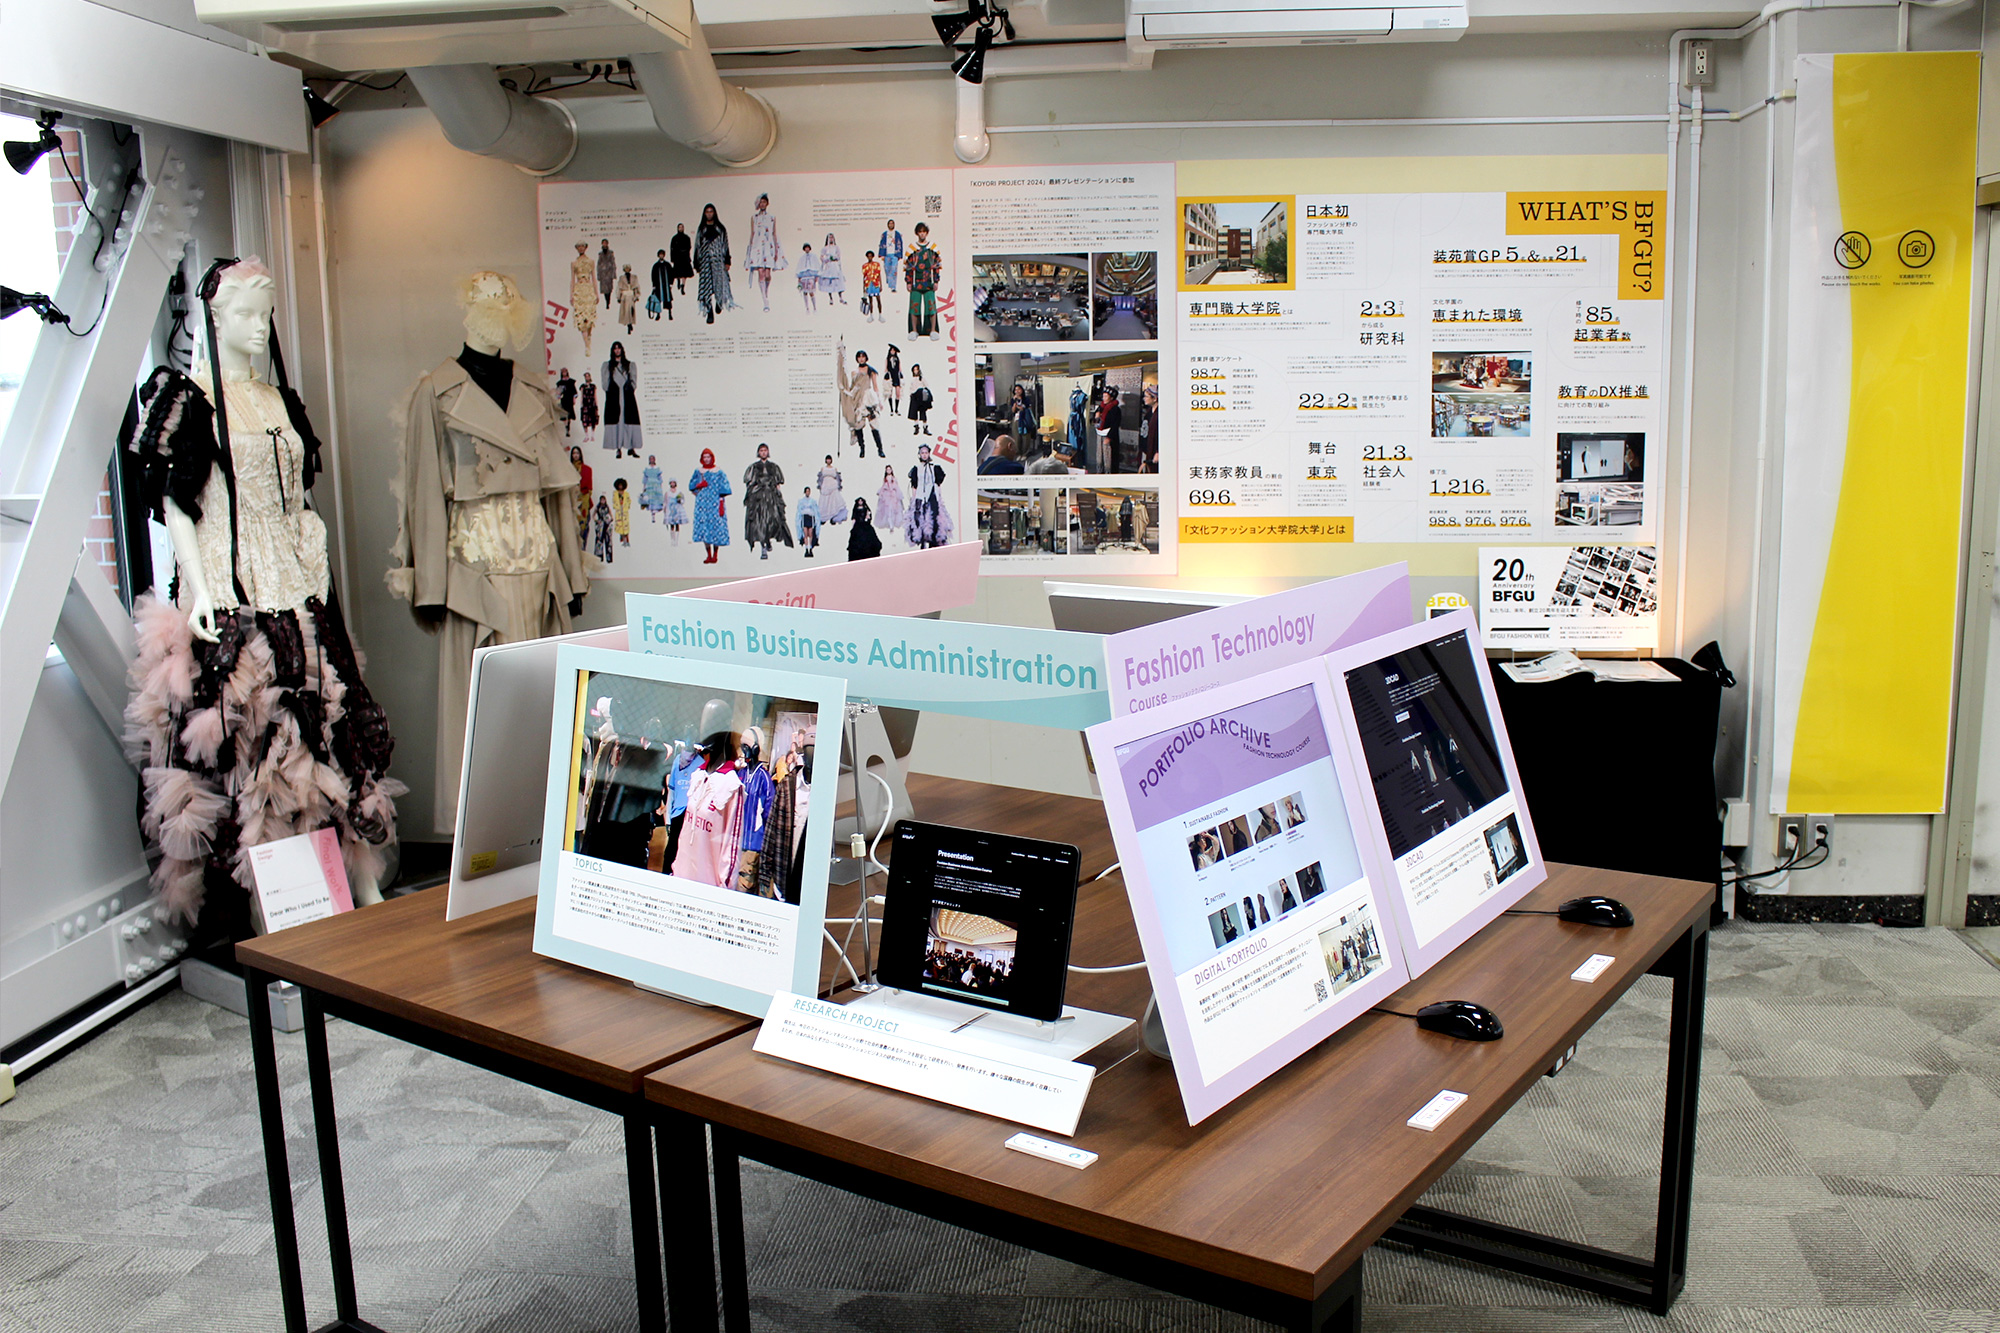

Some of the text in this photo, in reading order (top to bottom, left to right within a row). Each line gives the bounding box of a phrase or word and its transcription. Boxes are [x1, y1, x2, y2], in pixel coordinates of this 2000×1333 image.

[1049, 177, 1135, 185] 最終プレゼンテーションに参加
[1306, 204, 1350, 218] 日本初
[1519, 201, 1628, 221] WHAT'S
[1306, 221, 1358, 229] ファッション分野の
[1633, 201, 1654, 293] BFGU?
[1432, 309, 1523, 323] 恵まれた環境
[1360, 332, 1405, 345] 研究科
[1574, 328, 1631, 341] 起業者数
[1558, 385, 1649, 399] 教育のDX推進
[1308, 441, 1337, 455] 舞台
[1307, 466, 1338, 479] 東京
[1363, 465, 1406, 479] 社会人
[1184, 524, 1346, 536] 「文化ファッション大学院大学」とは
[1426, 596, 1470, 607] BFGU
[1493, 590, 1535, 602] BFGU
[642, 616, 1098, 690] Fashion Business Administration
[1125, 613, 1315, 690] Fashion Technology
[1129, 692, 1168, 714] Course
[1243, 735, 1311, 760] FASHION TECHNOLOGY COURSE
[1138, 718, 1271, 798] PORTFOLIO ARCHIVE
[937, 849, 974, 862] Presentation
[1405, 850, 1424, 868] 3DCAD
[574, 857, 603, 873] TOPICS
[1194, 937, 1268, 986] DIGITAL PORTFOLIO
[793, 999, 900, 1033] RESEARCH PROJECT
